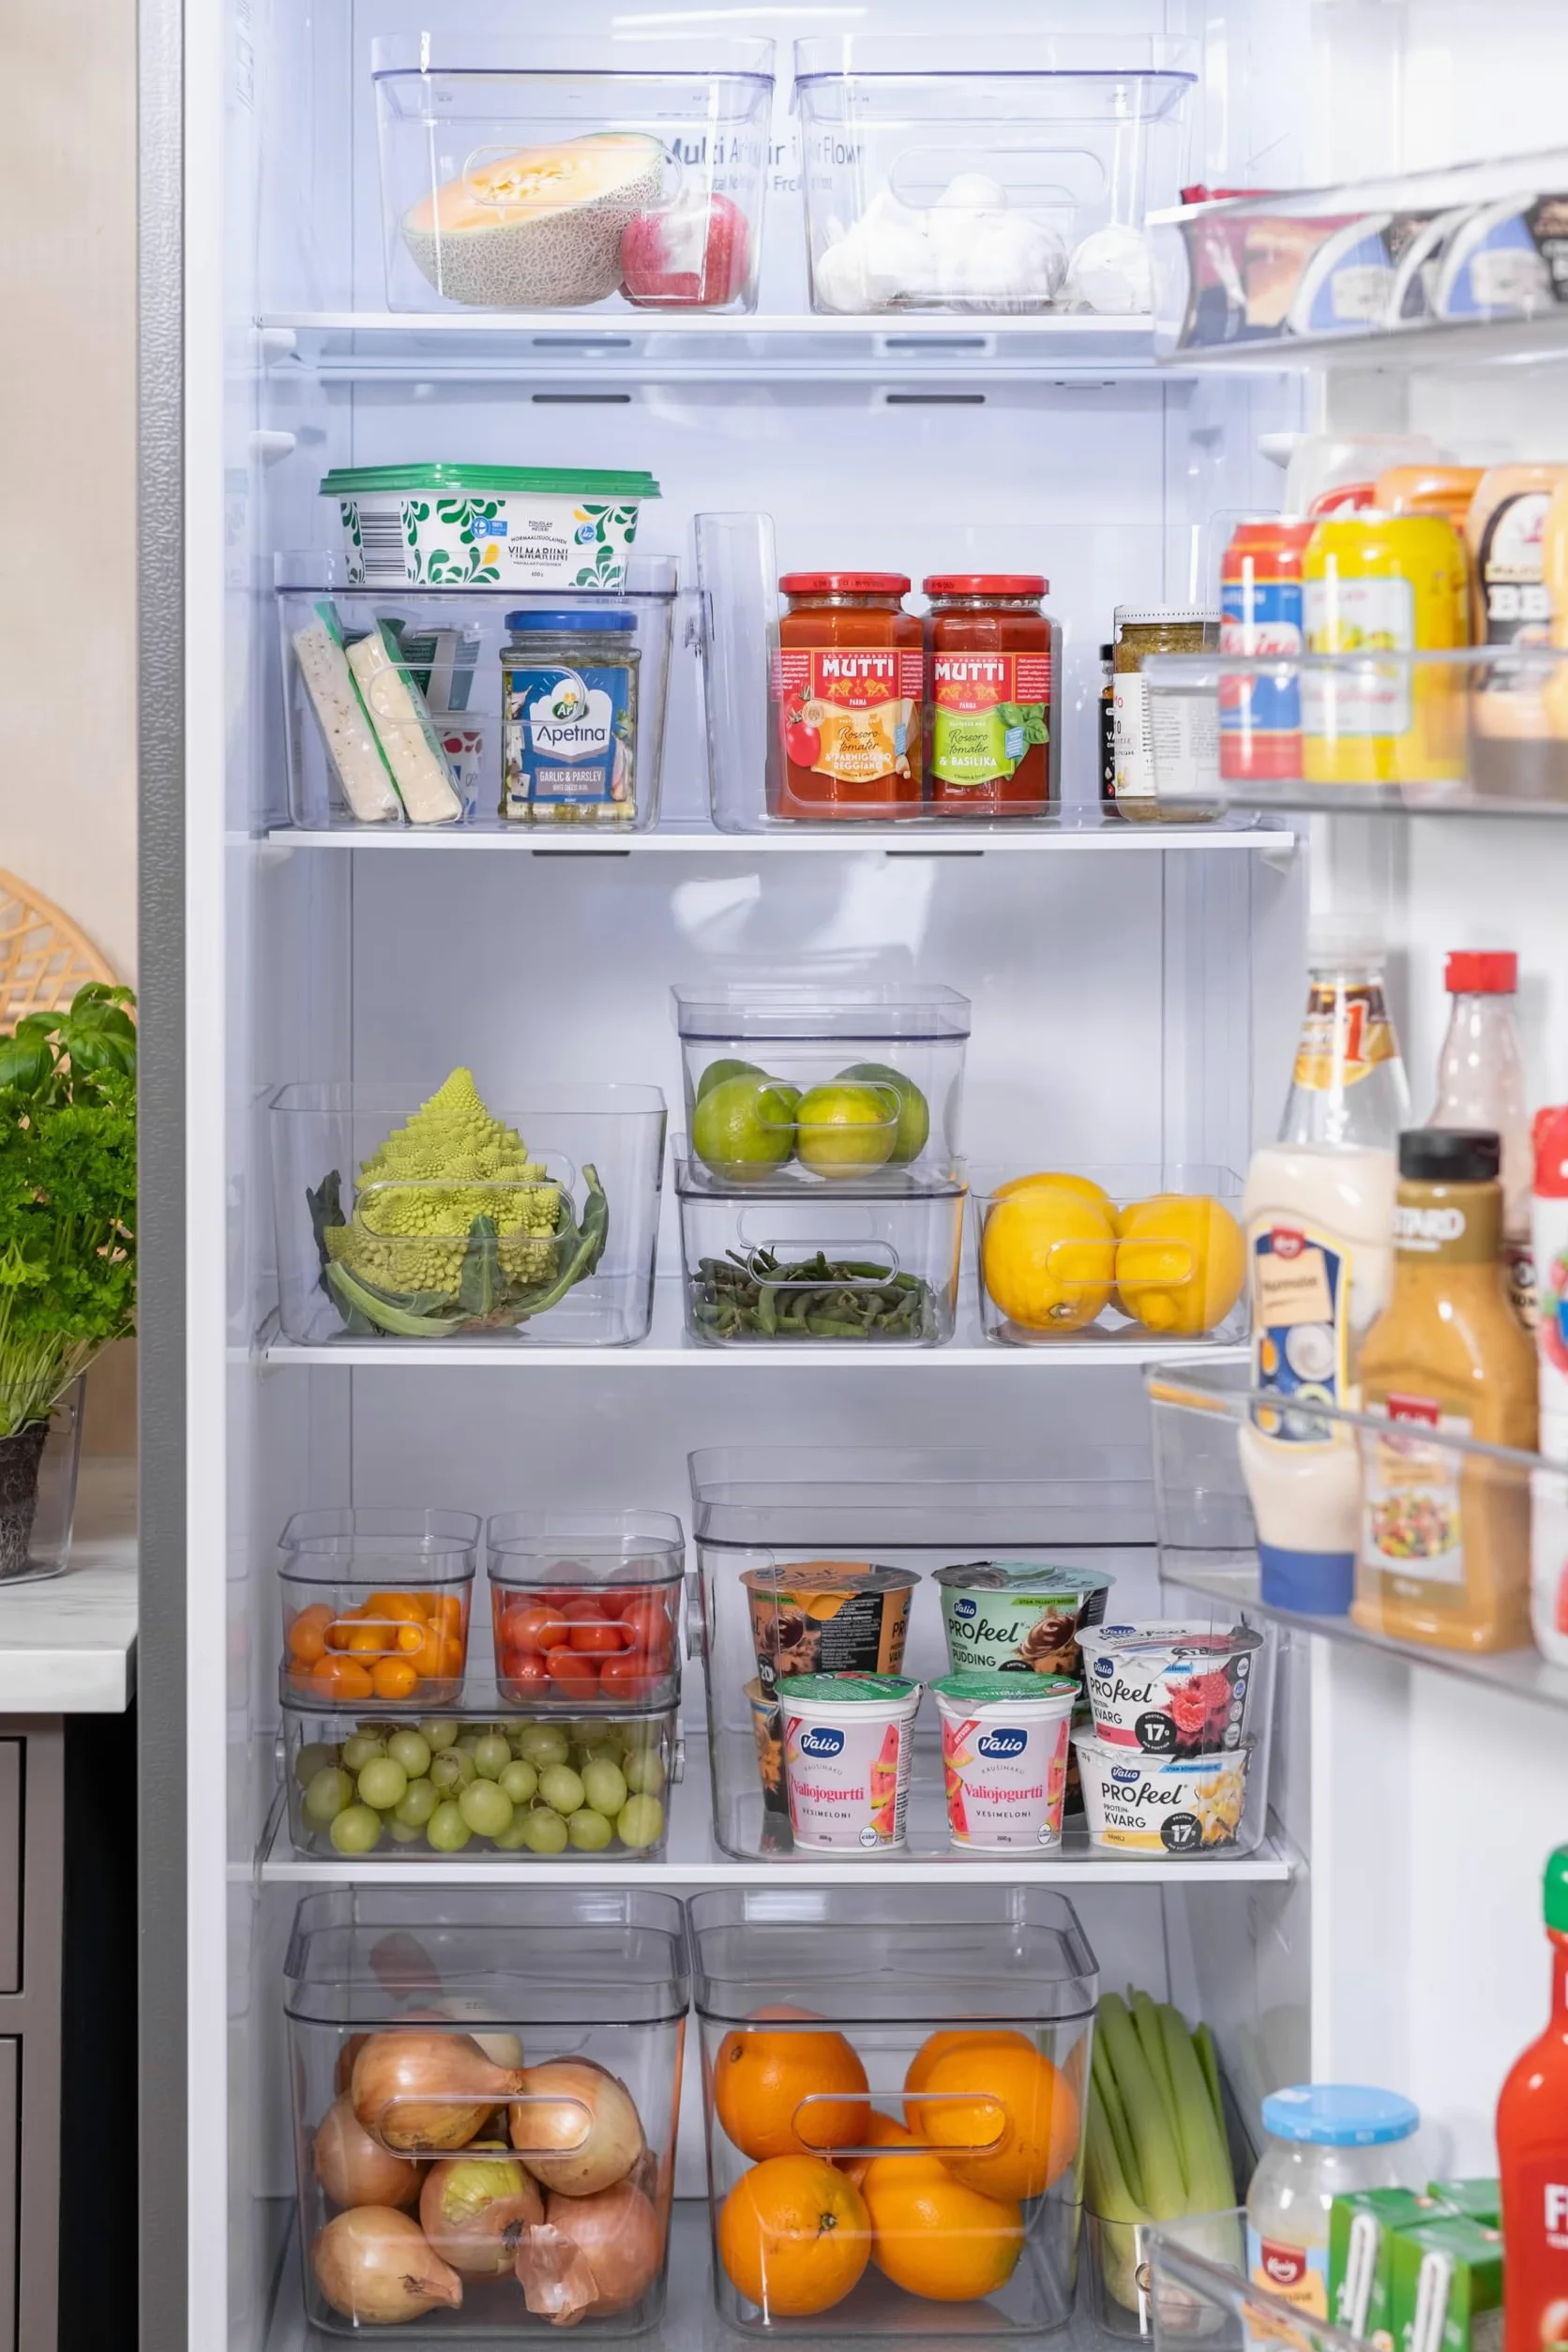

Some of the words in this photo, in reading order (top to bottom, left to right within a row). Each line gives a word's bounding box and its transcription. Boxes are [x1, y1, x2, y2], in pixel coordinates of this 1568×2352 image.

[511, 535, 567, 545] NORMAALISUOLAINEN
[508, 546, 568, 561] VILMARIINI
[822, 658, 894, 677] MUTTI
[935, 662, 1004, 681] MUTTI
[536, 724, 606, 746] Apetina
[951, 757, 997, 766] BASILIKA
[539, 770, 565, 782] GARLIC
[565, 771, 571, 782] &
[572, 770, 602, 782] PARSLEY
[955, 1602, 975, 1615] Valio
[948, 1618, 1019, 1644] PROfeel
[952, 1651, 997, 1666] PUDDING
[1094, 1661, 1113, 1675] Valio
[1090, 1678, 1153, 1703] PROfeel
[1094, 1707, 1123, 1724] KVARG
[803, 1736, 840, 1752] Valio
[981, 1736, 1023, 1752] Valio
[1111, 1766, 1139, 1779] Valio
[793, 1783, 864, 1802] Valiojogurtti
[964, 1783, 1043, 1803] Valiojogurtti
[1101, 1782, 1184, 1807] PROfeel
[803, 1809, 852, 1818] VESIMELONI
[1105, 1812, 1147, 1828] KVARG
